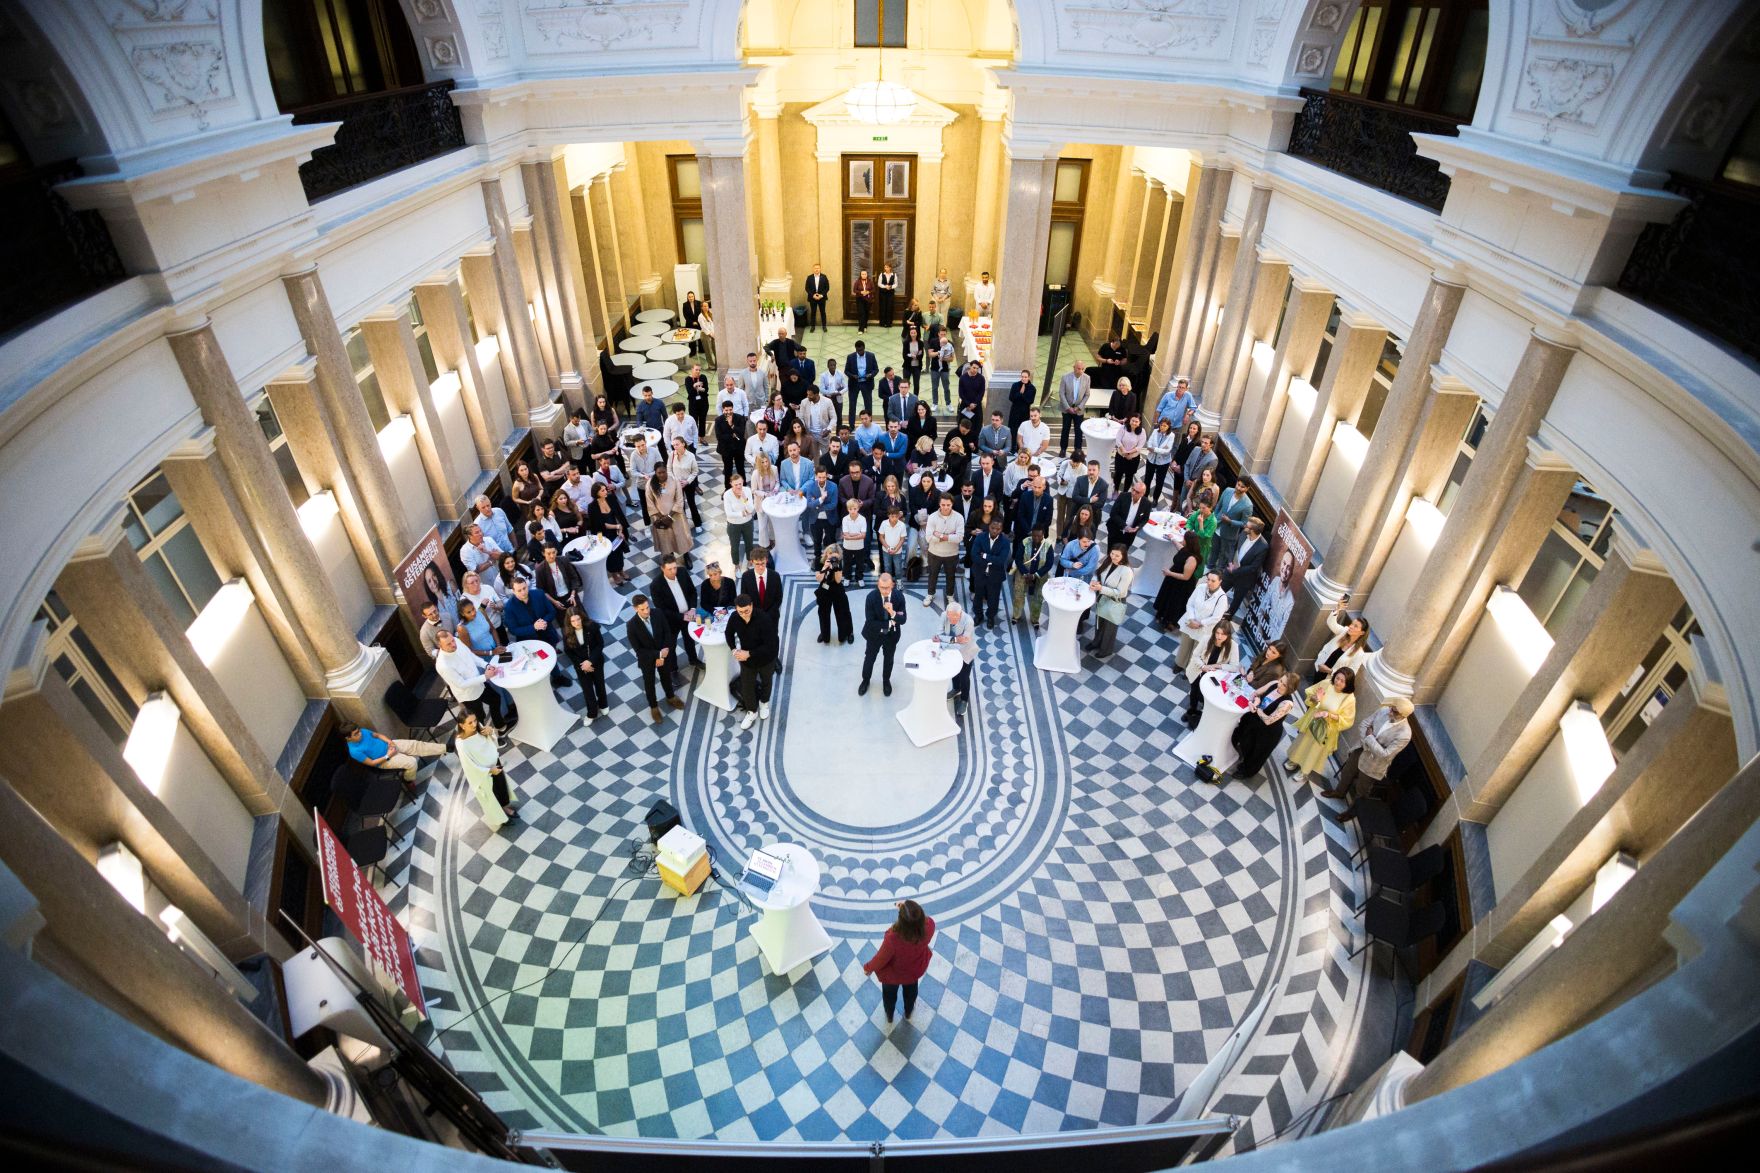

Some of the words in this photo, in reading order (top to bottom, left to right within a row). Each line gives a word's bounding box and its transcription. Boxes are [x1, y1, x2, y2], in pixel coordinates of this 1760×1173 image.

[403, 545, 438, 589] ÖSTERREICH
[404, 539, 437, 577] ZUSAMMEN:
[350, 858, 372, 953] Mädchen
[374, 899, 395, 980] Zukunft
